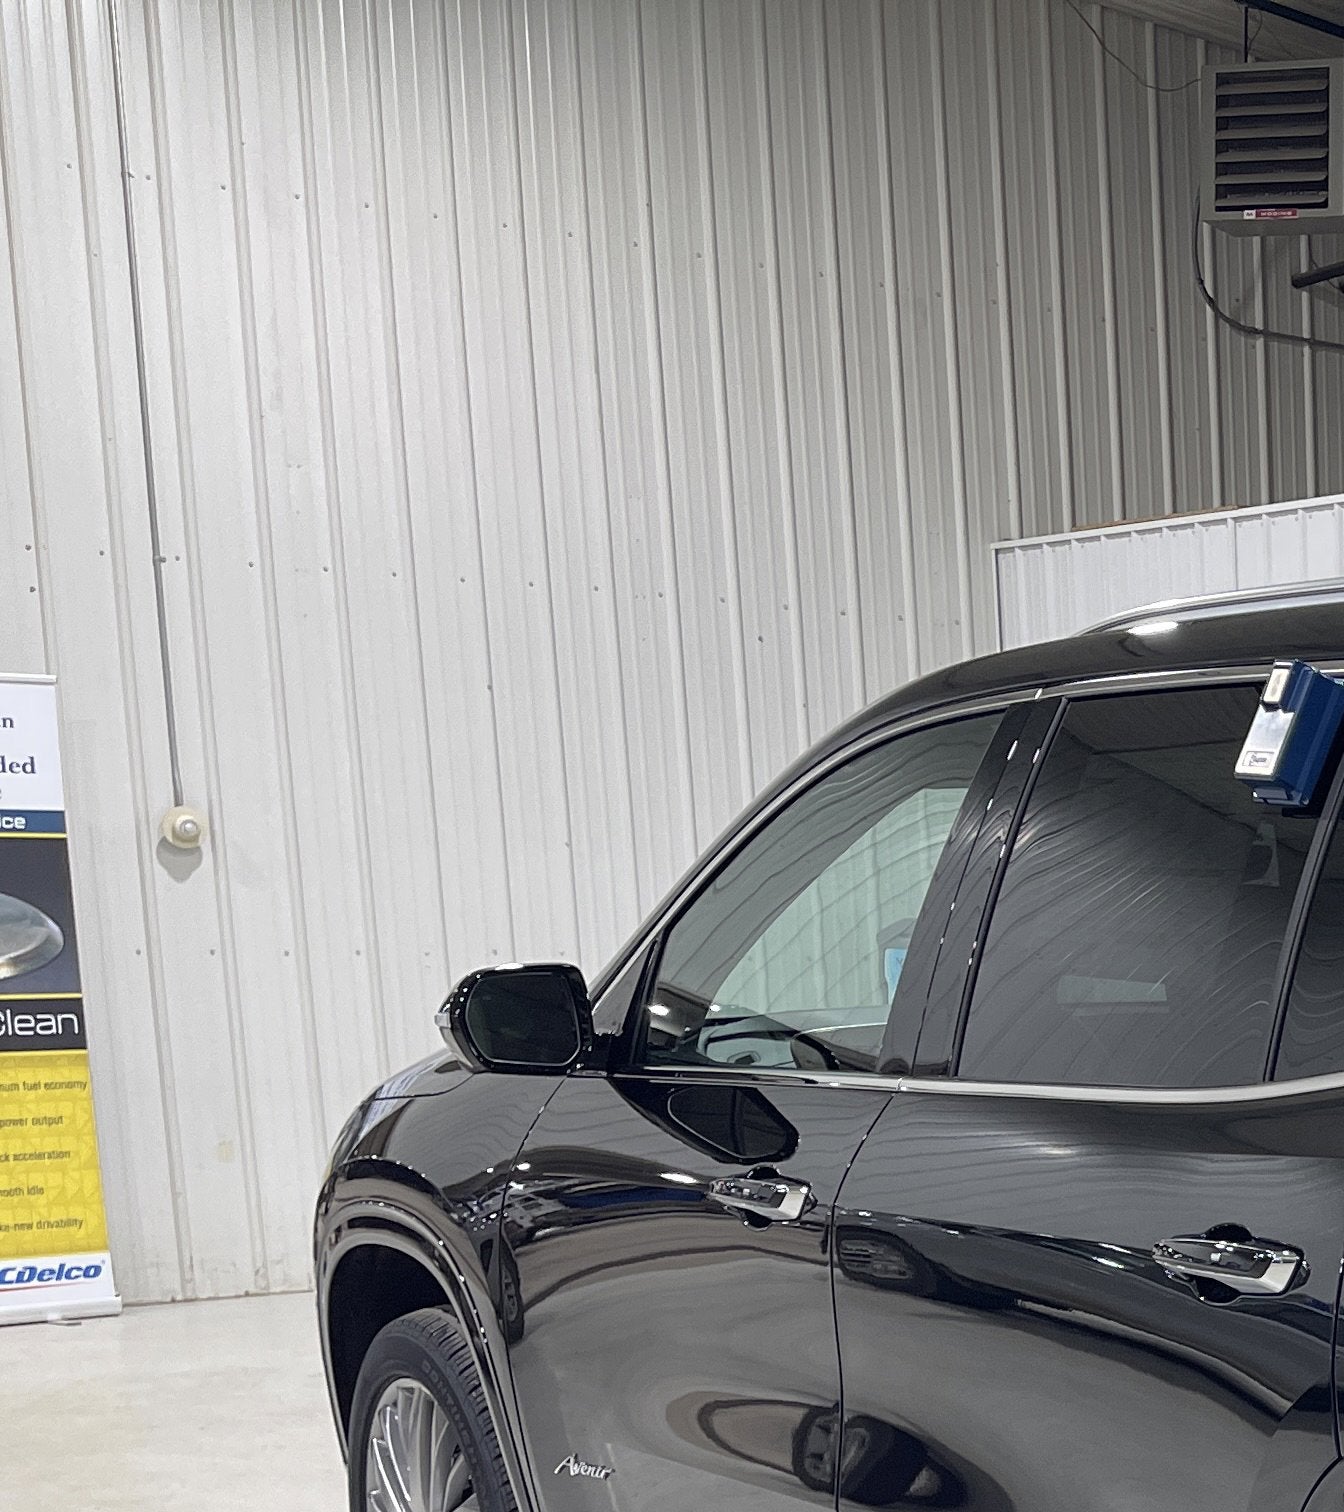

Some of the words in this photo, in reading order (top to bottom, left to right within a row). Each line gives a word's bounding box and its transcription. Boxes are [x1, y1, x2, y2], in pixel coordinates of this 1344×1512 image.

[44, 1080, 88, 1092] economy
[31, 1115, 64, 1128] output
[13, 1150, 71, 1161] acceleration
[36, 1219, 83, 1230] drivability
[554, 1453, 613, 1480] Avenir
